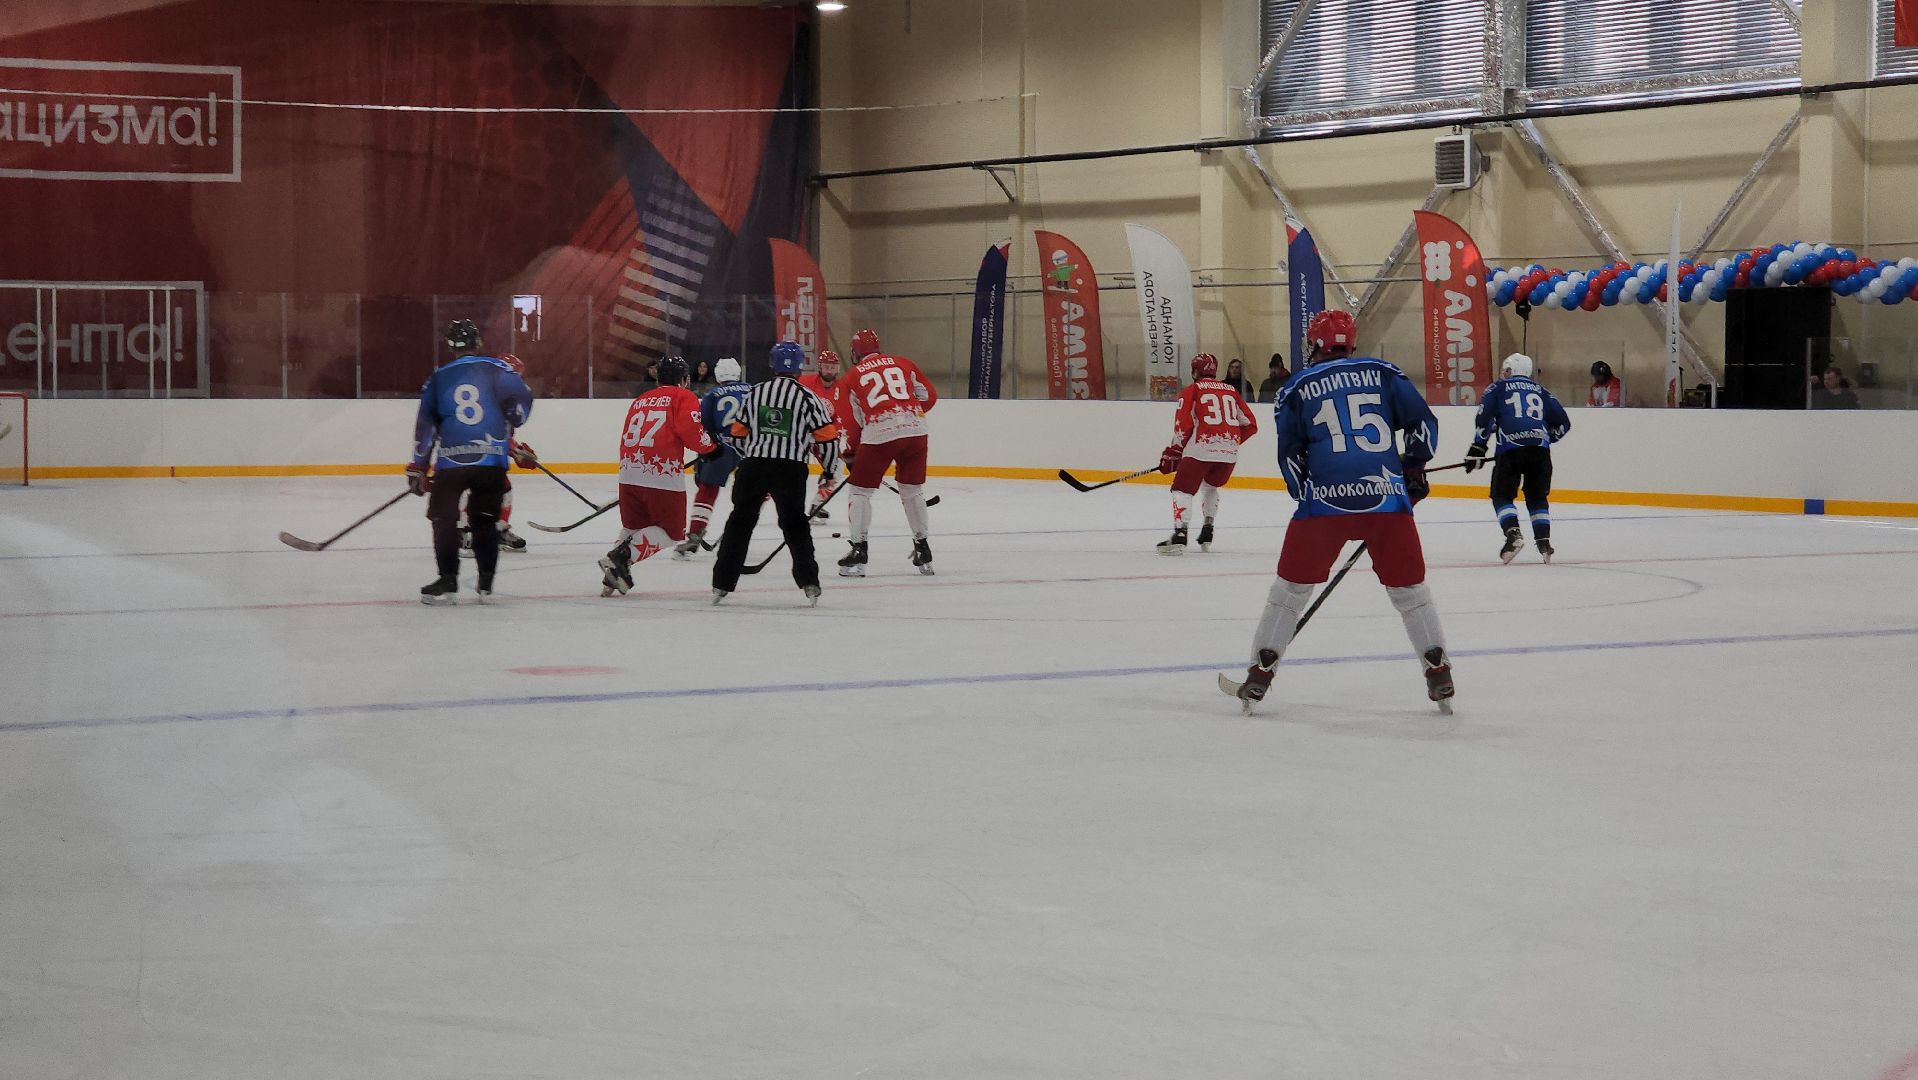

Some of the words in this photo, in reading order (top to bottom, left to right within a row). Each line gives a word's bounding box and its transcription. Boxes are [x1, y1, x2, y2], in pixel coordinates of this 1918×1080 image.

[0, 307, 184, 365] ента!
[453, 384, 484, 425] 8
[860, 366, 910, 408] 28
[1504, 392, 1544, 420] 18
[623, 411, 667, 447] 87
[1201, 393, 1239, 426] 30
[1312, 393, 1392, 453] 15
